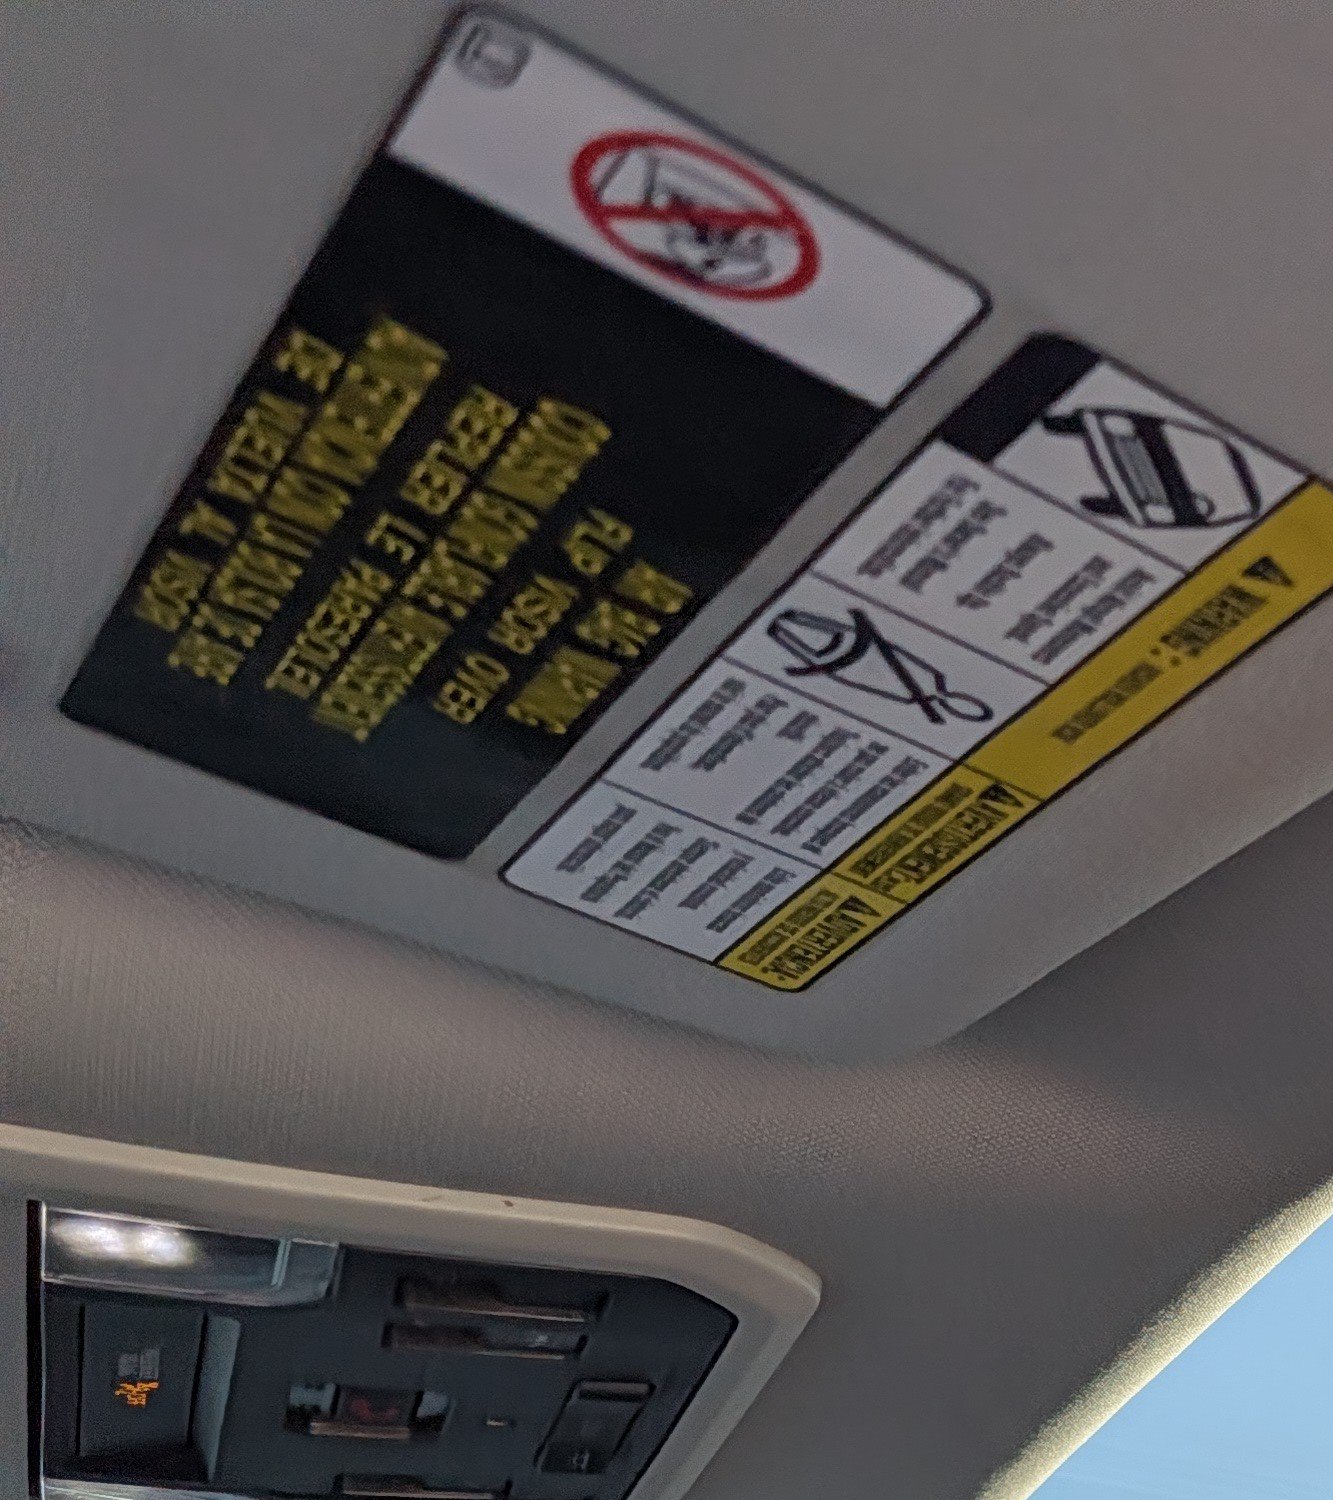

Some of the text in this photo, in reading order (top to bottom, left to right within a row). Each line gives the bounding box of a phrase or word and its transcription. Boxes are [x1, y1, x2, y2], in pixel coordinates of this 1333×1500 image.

[364, 511, 426, 564] LE
[432, 508, 633, 724] FLIP VISOR OVER
